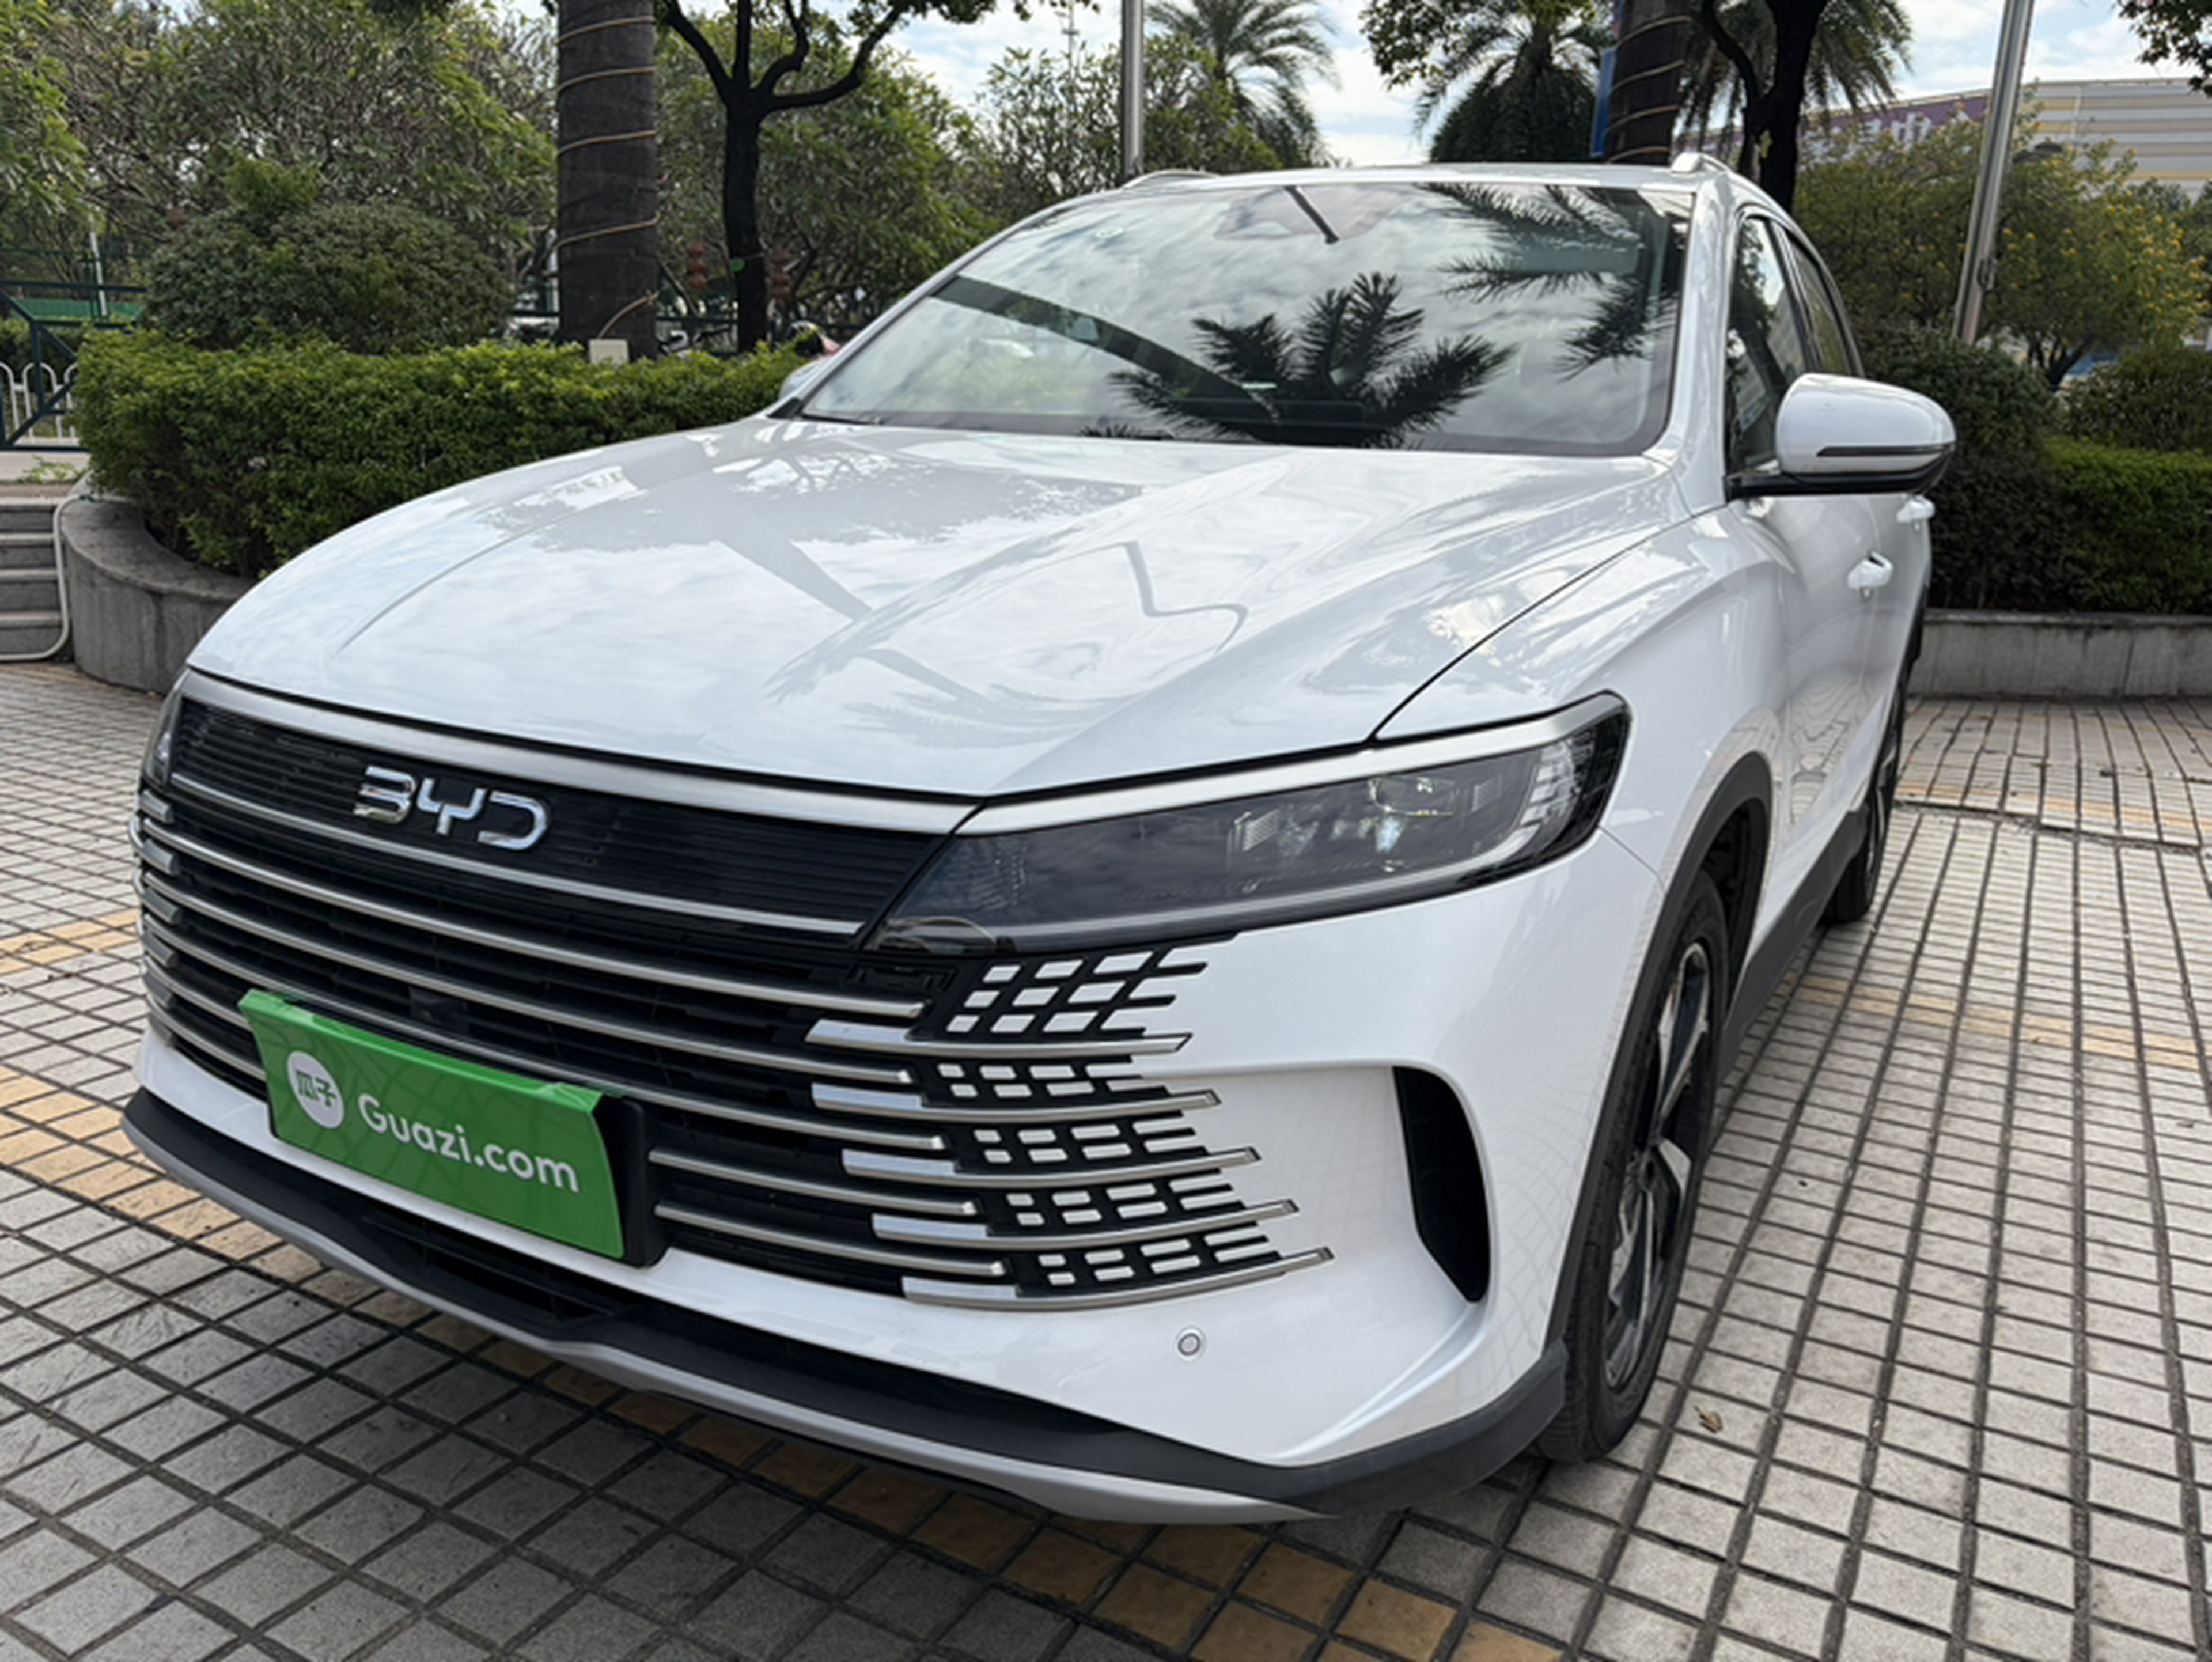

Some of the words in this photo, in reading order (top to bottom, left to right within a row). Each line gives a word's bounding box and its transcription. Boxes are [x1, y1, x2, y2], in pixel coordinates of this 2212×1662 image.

[353, 765, 549, 851] BYD
[295, 1069, 337, 1107] 瓜子
[357, 1093, 580, 1194] Guazi.com
